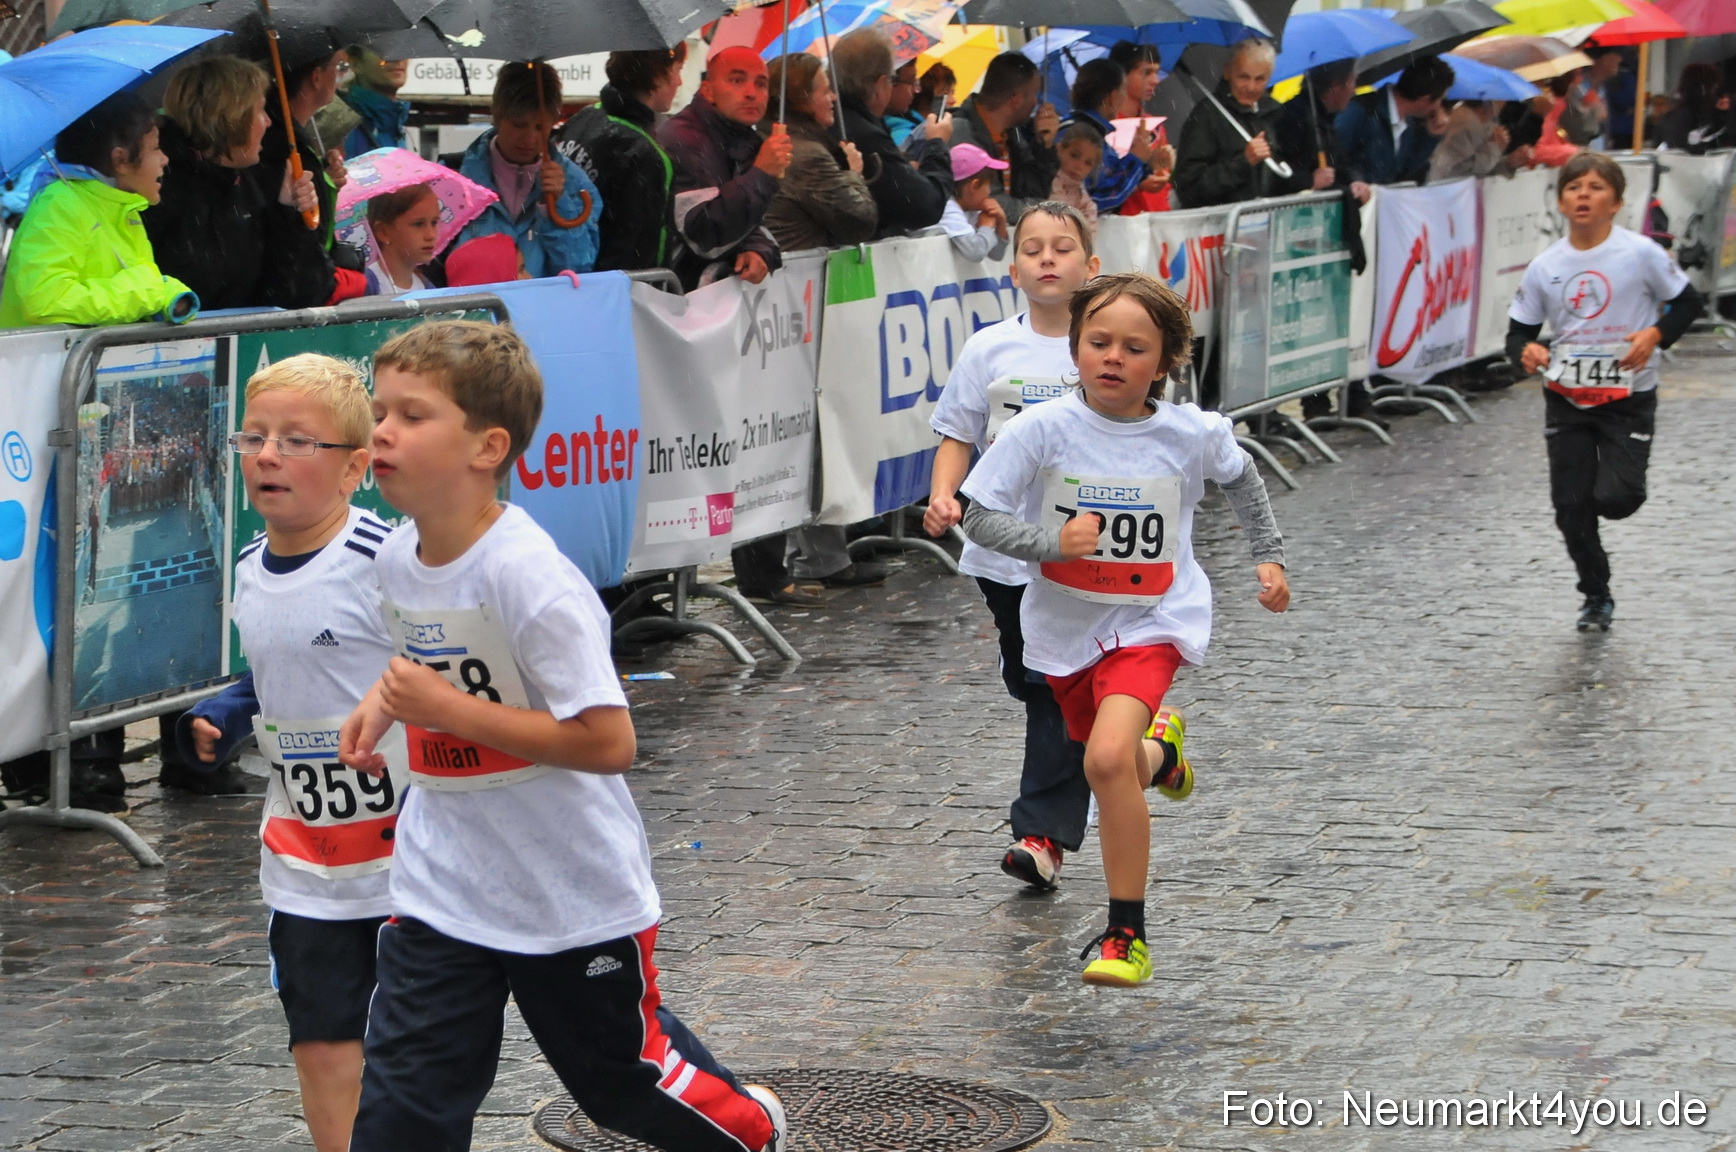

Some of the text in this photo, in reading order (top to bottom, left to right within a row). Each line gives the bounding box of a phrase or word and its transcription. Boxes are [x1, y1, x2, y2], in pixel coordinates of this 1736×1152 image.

[414, 62, 481, 80] Gebäude
[558, 65, 591, 81] mbH
[741, 279, 813, 370] Xplus1
[758, 414, 768, 447] in
[648, 432, 738, 474] Ihr Teleko
[1078, 485, 1141, 501] BOCK
[311, 638, 339, 647] adidas
[278, 730, 339, 749] BOCK
[420, 737, 481, 770] Kilian
[270, 760, 395, 821] 7359
[586, 960, 622, 977] adidas
